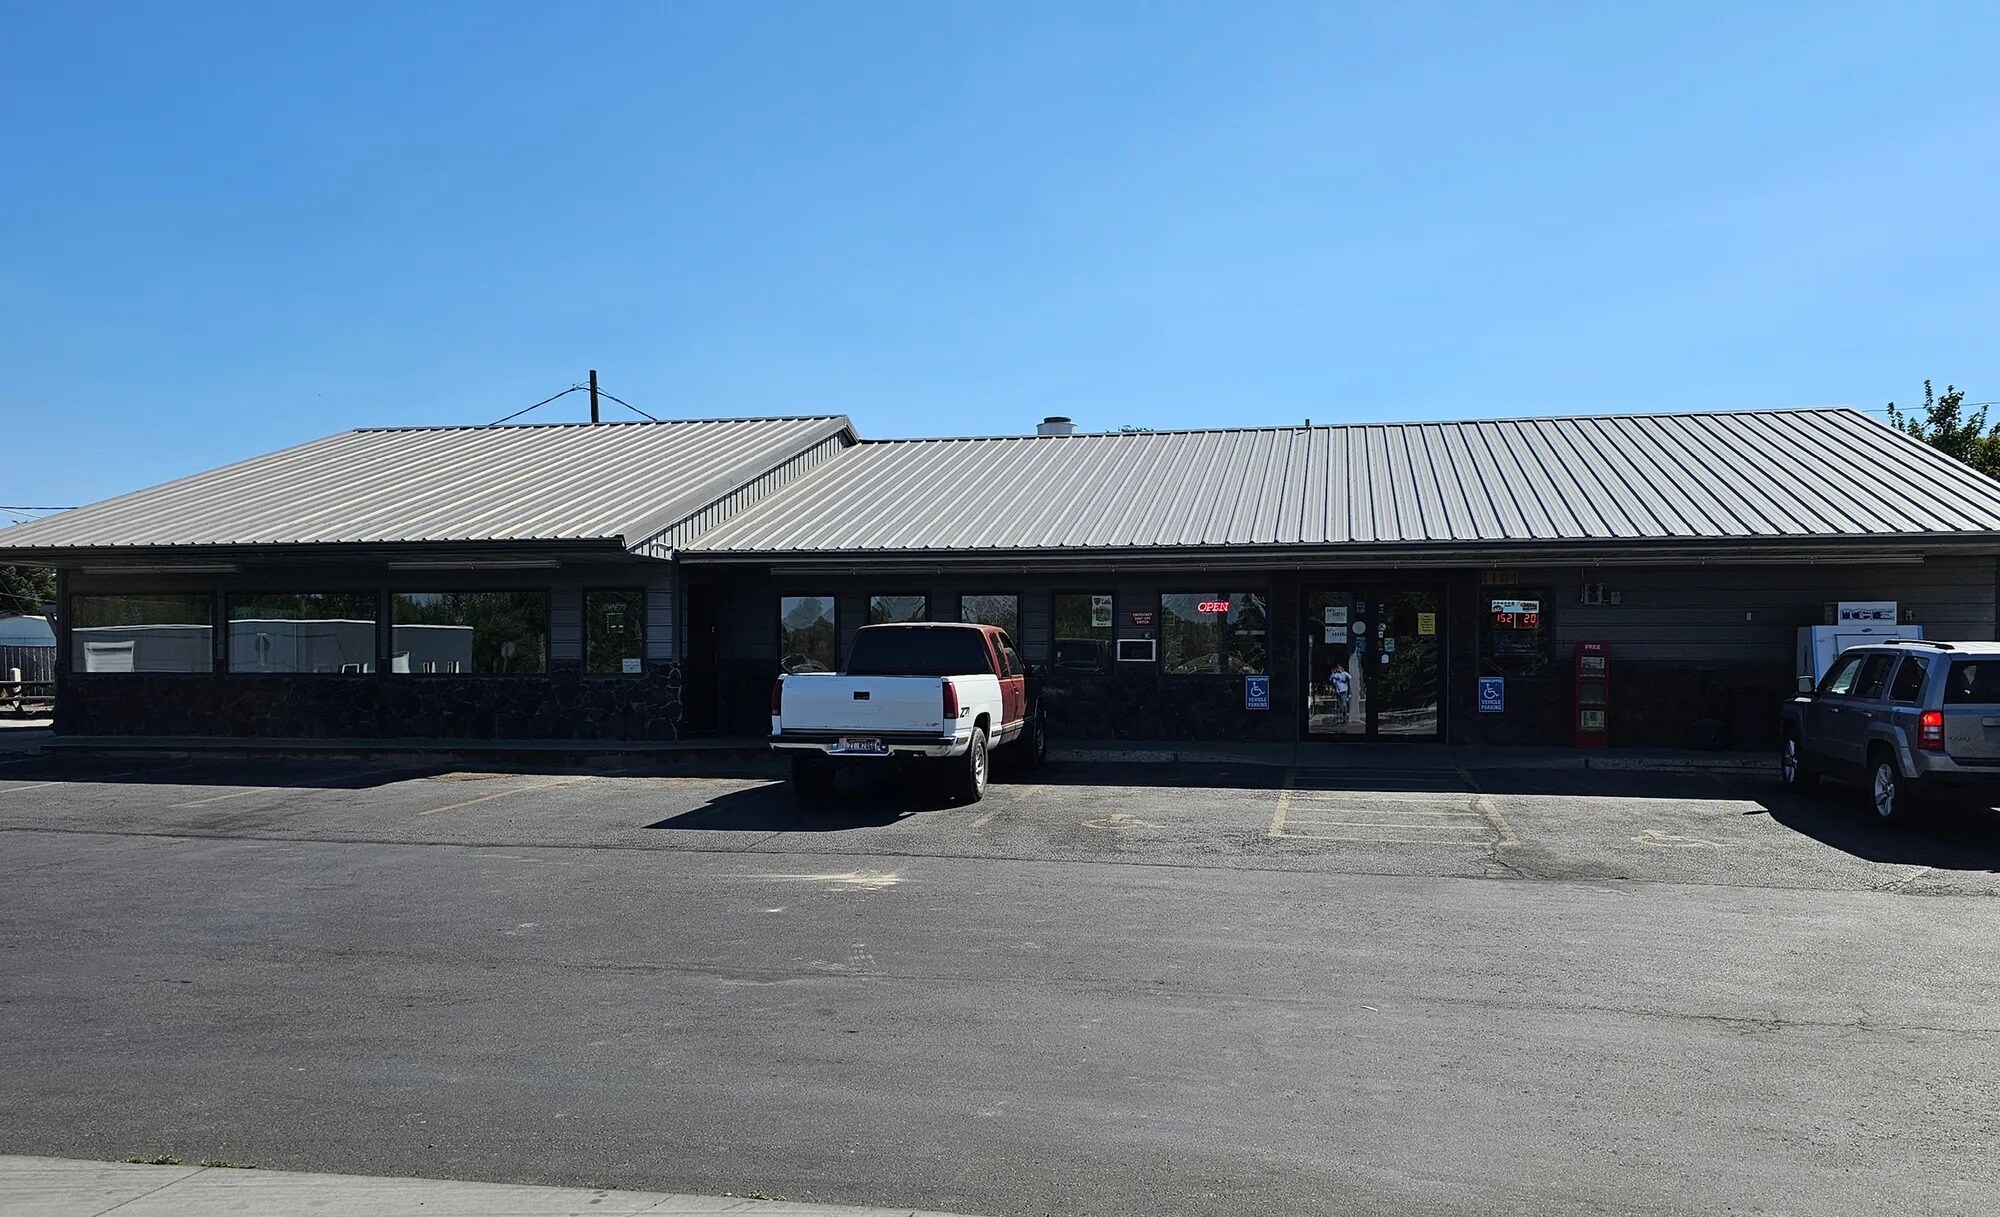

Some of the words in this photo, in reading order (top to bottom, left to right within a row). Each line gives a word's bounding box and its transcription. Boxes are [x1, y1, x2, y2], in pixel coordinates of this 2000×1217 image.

[1197, 602, 1229, 612] OPEN
[1496, 613, 1513, 623] 152
[1523, 613, 1536, 624] 20
[1841, 608, 1895, 621] ICE
